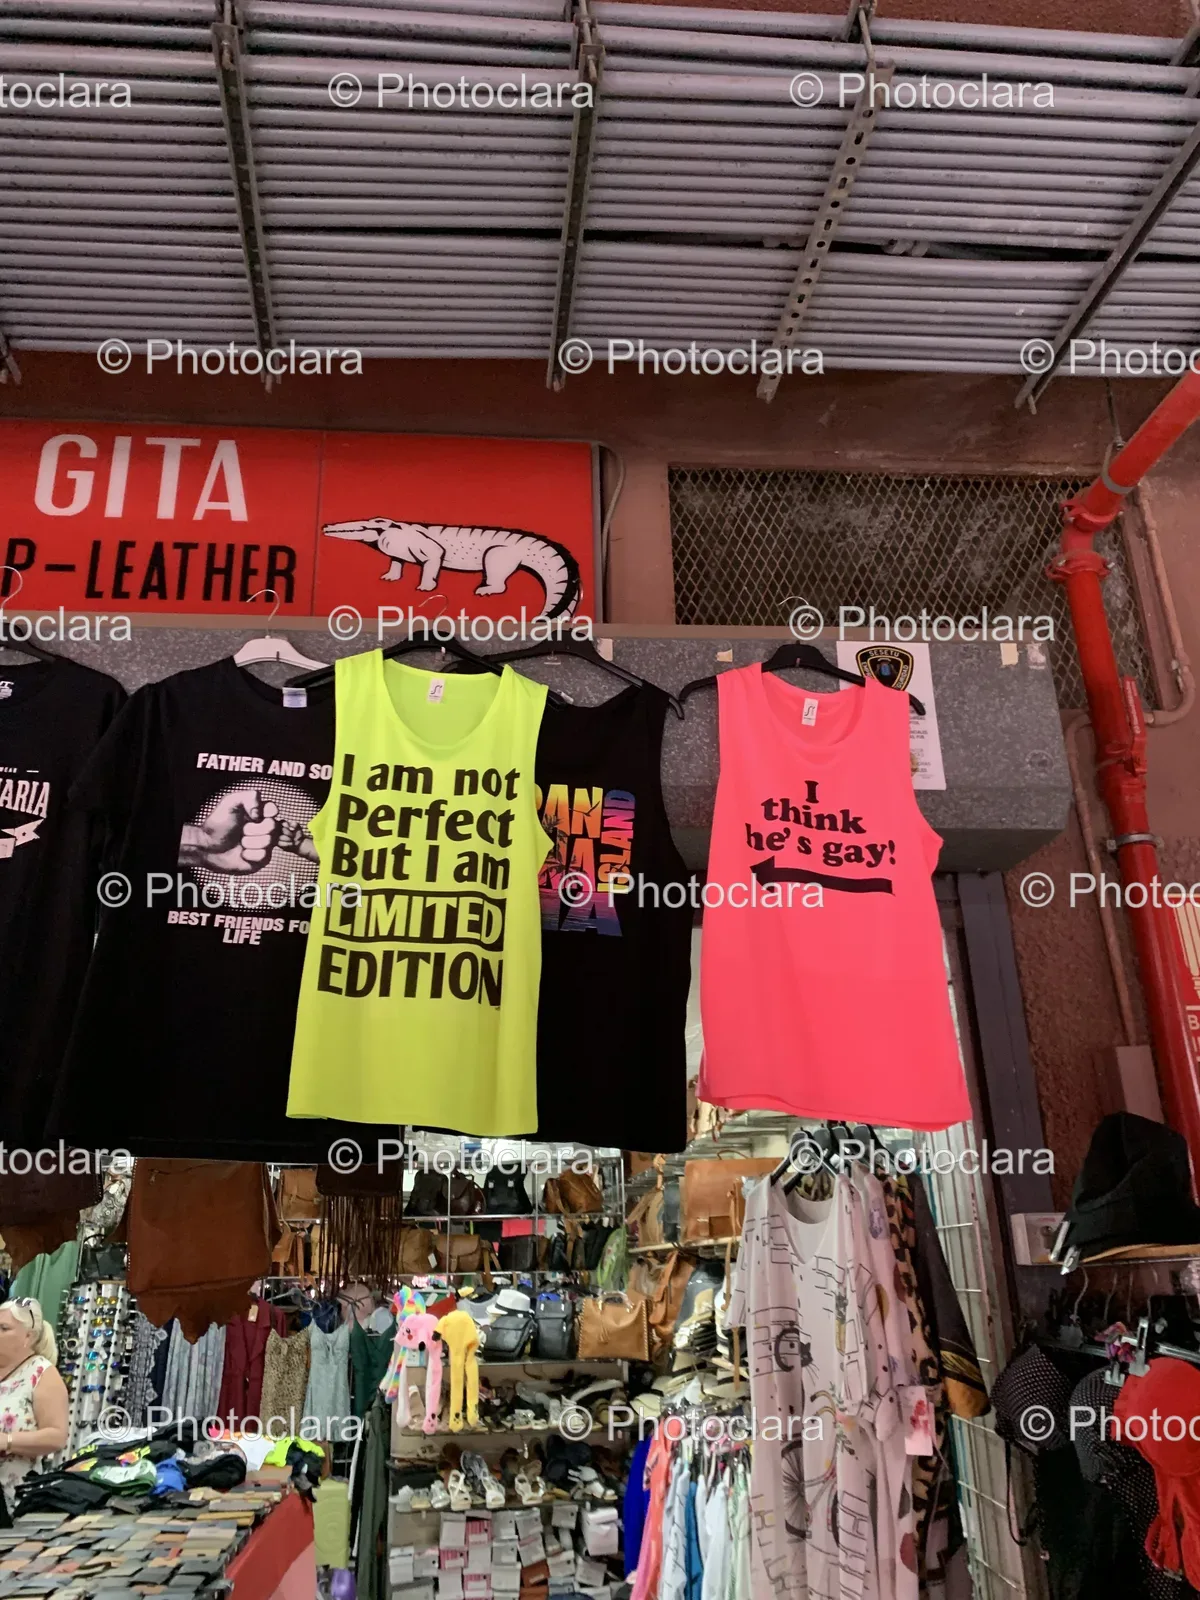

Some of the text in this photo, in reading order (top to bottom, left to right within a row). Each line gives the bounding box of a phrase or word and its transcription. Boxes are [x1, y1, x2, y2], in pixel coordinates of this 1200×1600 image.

[34, 433, 249, 522] GITA
[868, 649, 900, 658] SESETU
[196, 753, 333, 780] FATHER AND SO
[341, 753, 521, 801] I am not
[0, 777, 51, 819] ARIA
[804, 780, 820, 804] I
[336, 793, 516, 849] Perfect
[761, 797, 867, 834] think
[331, 835, 511, 891] But I am
[597, 789, 636, 894] ISLAND
[745, 822, 896, 868] he's gay!
[167, 910, 211, 927] BEST
[213, 913, 284, 932] FRIENDS
[222, 928, 263, 946] LIFE
[326, 886, 504, 945] LIMITED
[317, 944, 504, 1011] EDITION
